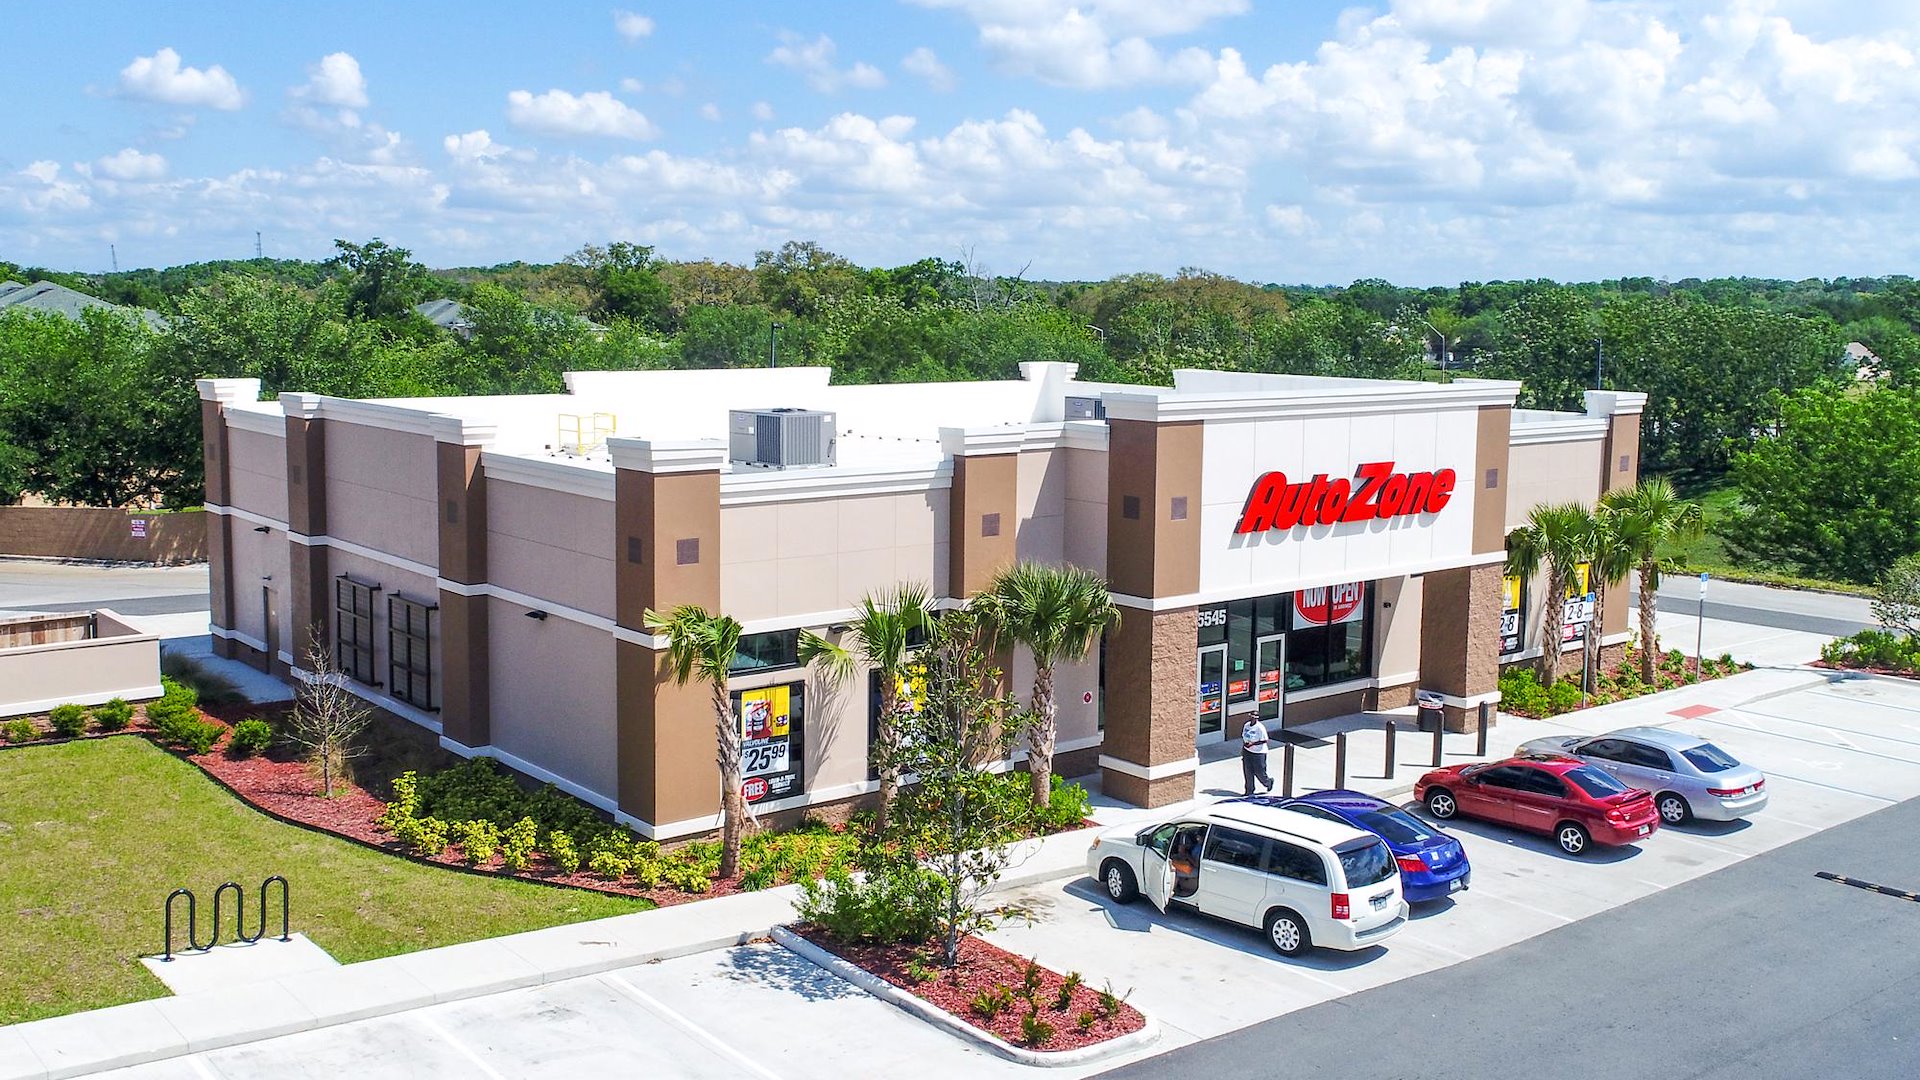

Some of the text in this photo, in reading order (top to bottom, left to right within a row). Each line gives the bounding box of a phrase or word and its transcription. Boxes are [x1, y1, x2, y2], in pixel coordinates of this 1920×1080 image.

[1234, 461, 1456, 534] AutoZone
[1198, 609, 1227, 627] 5545
[743, 781, 765, 798] FREE
